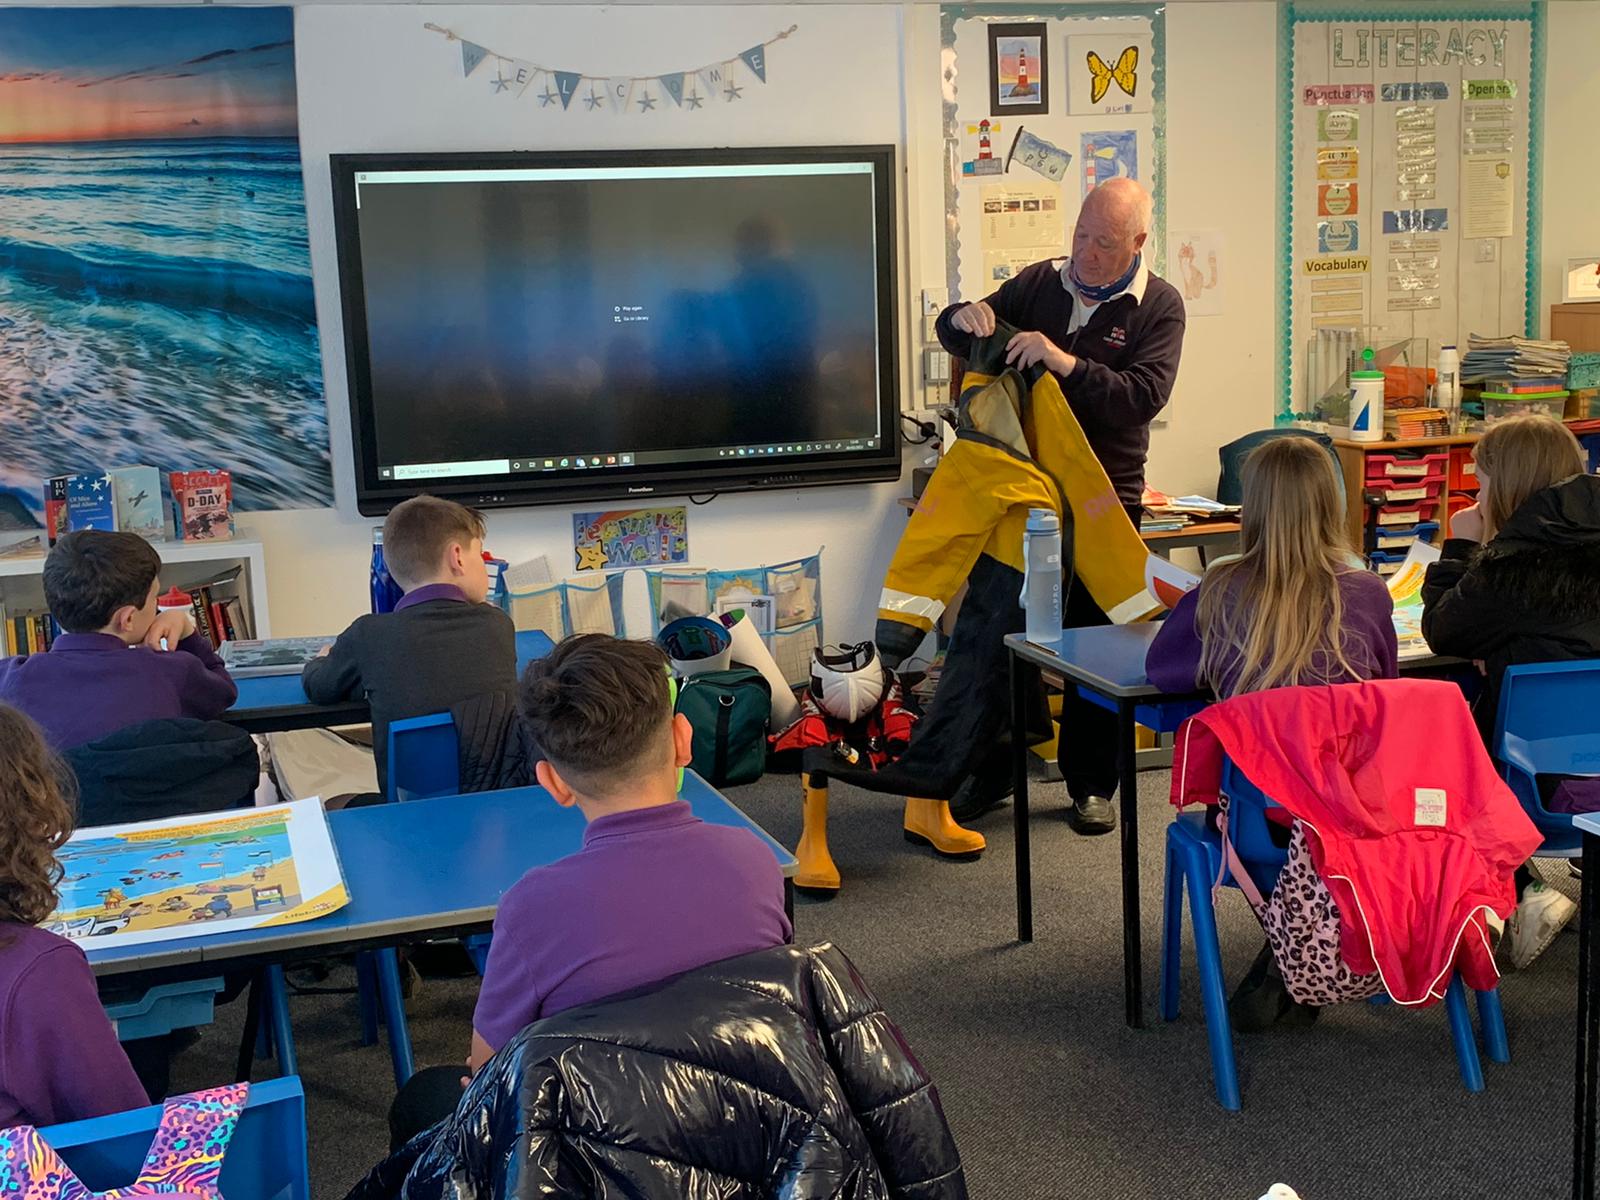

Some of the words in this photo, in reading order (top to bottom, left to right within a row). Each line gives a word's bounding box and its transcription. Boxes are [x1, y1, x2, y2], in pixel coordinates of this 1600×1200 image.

[1333, 27, 1509, 68] LITERACY
[1468, 83, 1511, 96] Openers
[1305, 258, 1368, 272] Vocabulary
[187, 494, 221, 507] D-DAY
